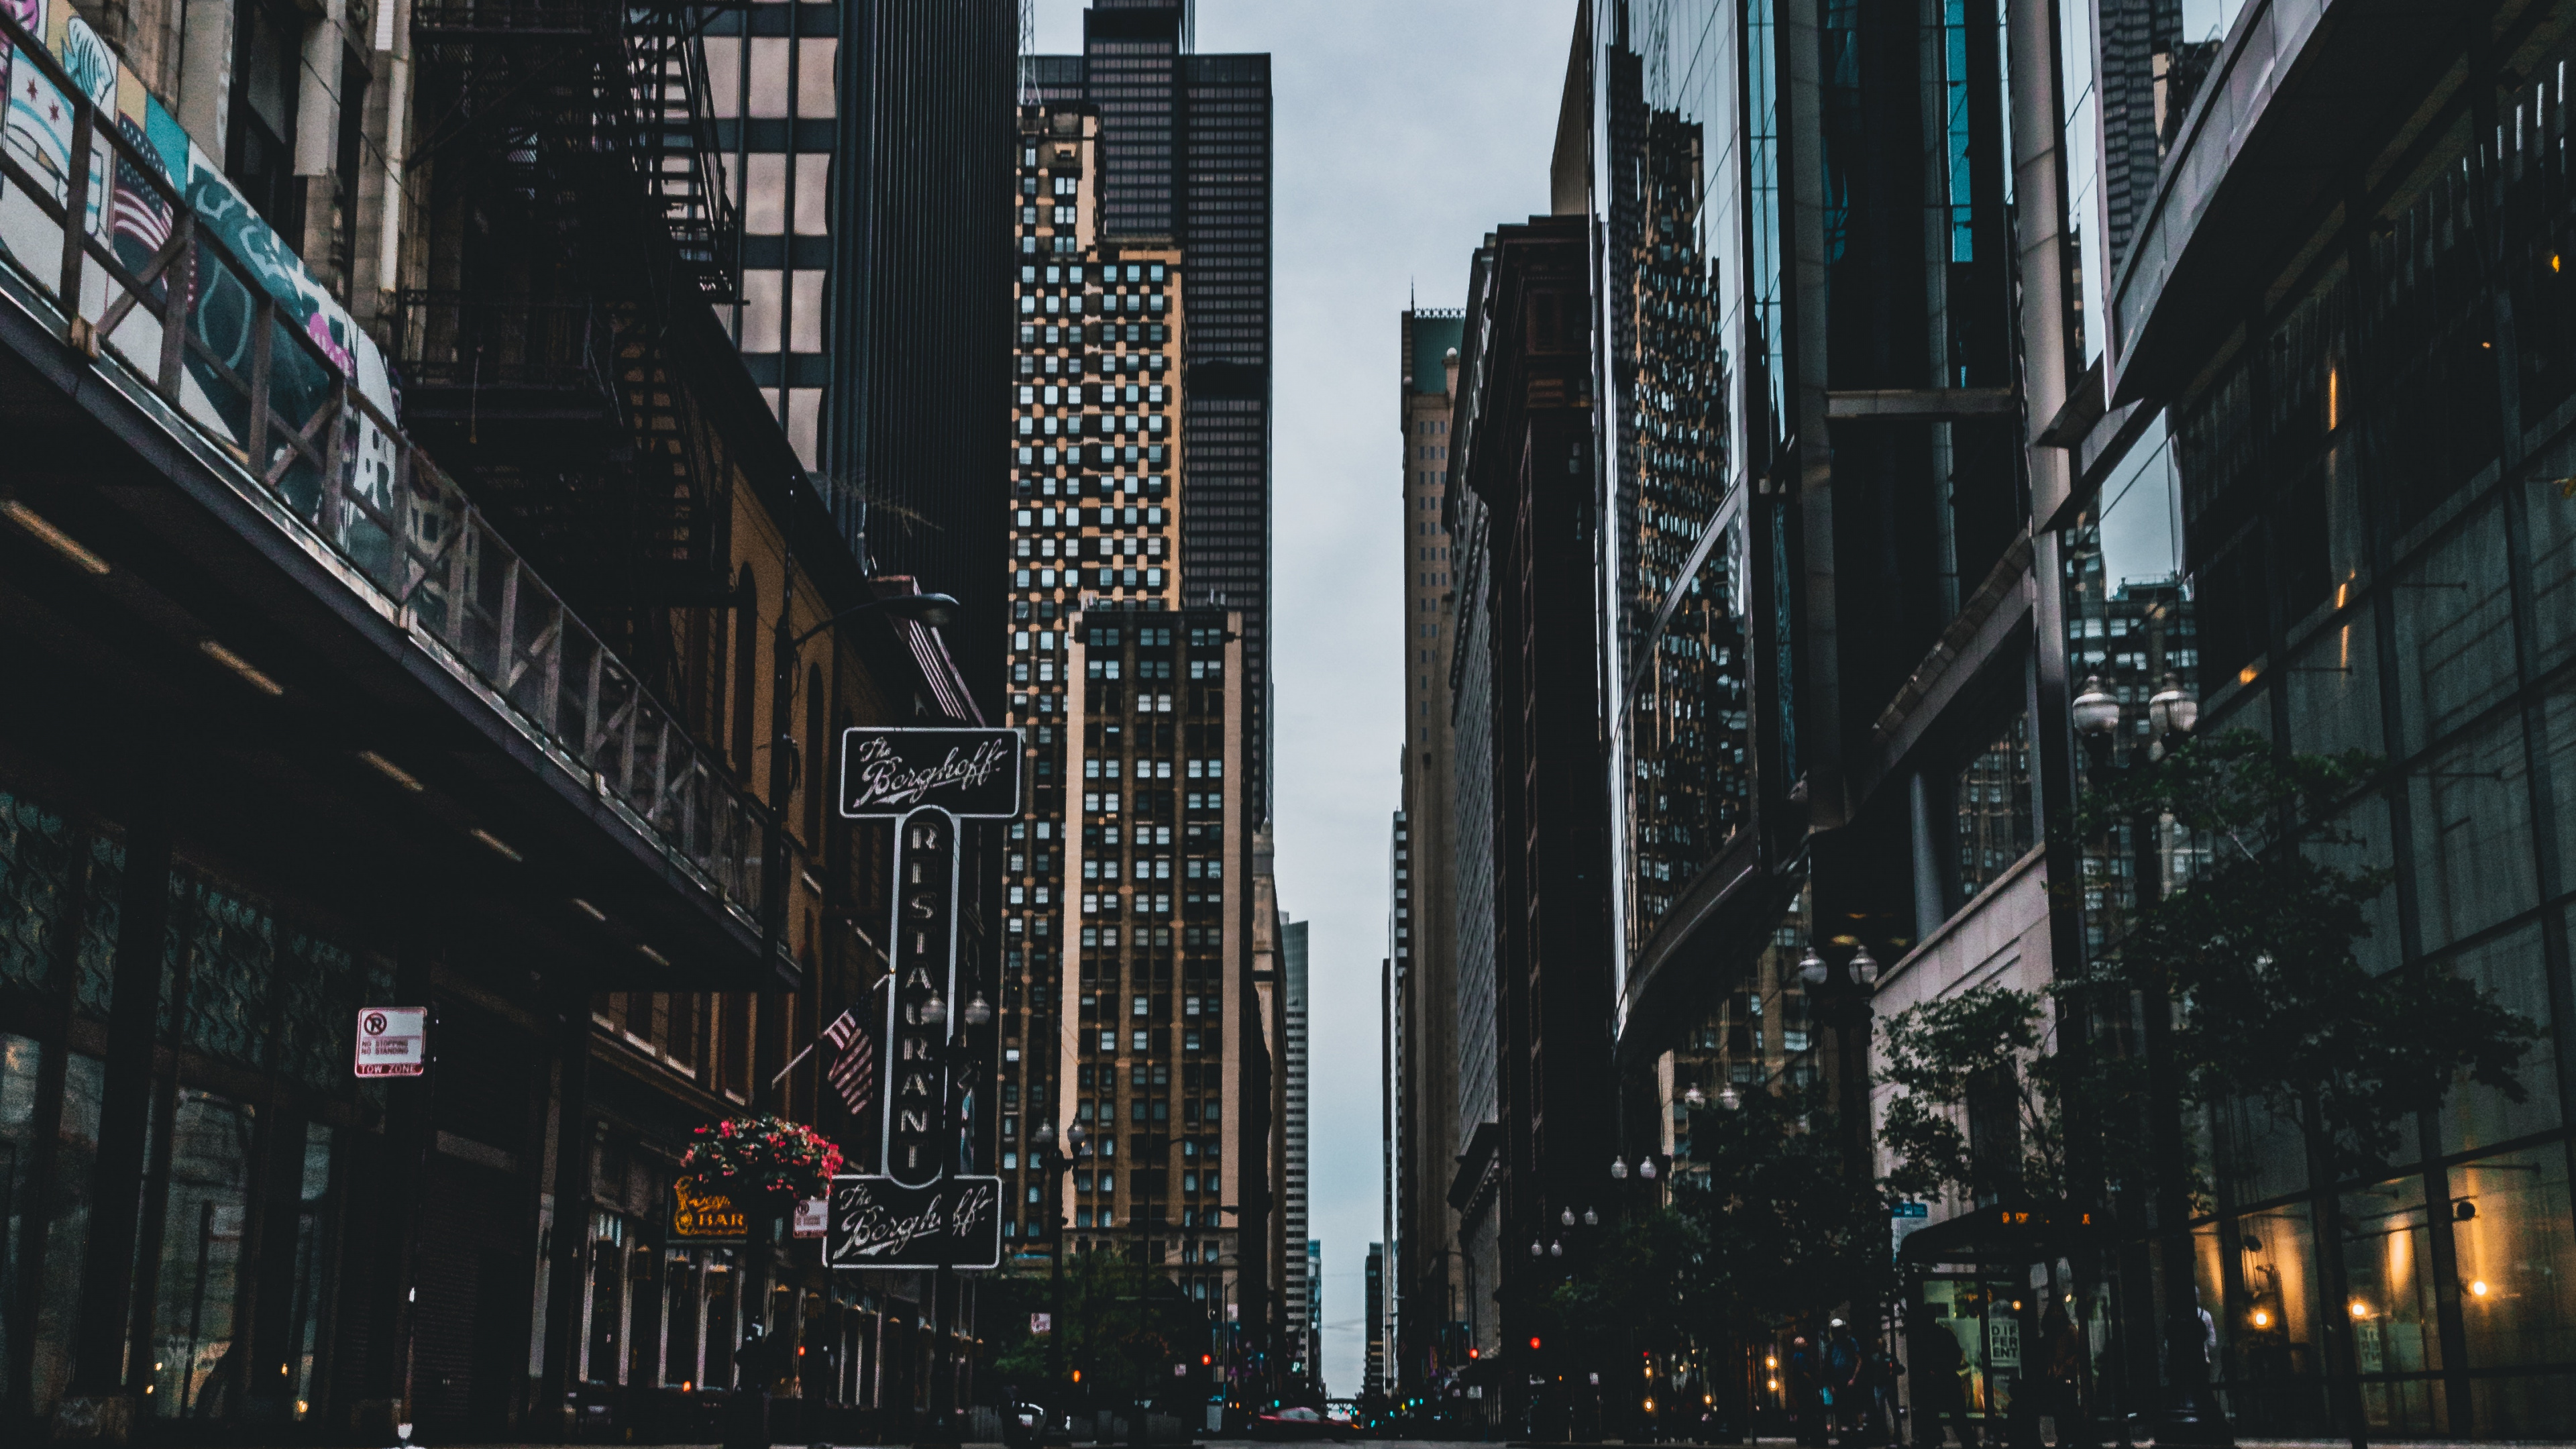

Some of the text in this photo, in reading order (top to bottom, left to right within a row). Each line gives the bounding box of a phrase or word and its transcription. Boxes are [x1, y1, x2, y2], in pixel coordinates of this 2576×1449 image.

[859, 737, 892, 763] The
[853, 739, 1008, 808] Berghoff
[362, 1065, 382, 1073] TOW
[839, 1183, 871, 1210] The
[700, 1214, 743, 1226] BAR
[833, 1185, 993, 1260] Berghff
[1993, 1348, 2017, 1358] ENT
